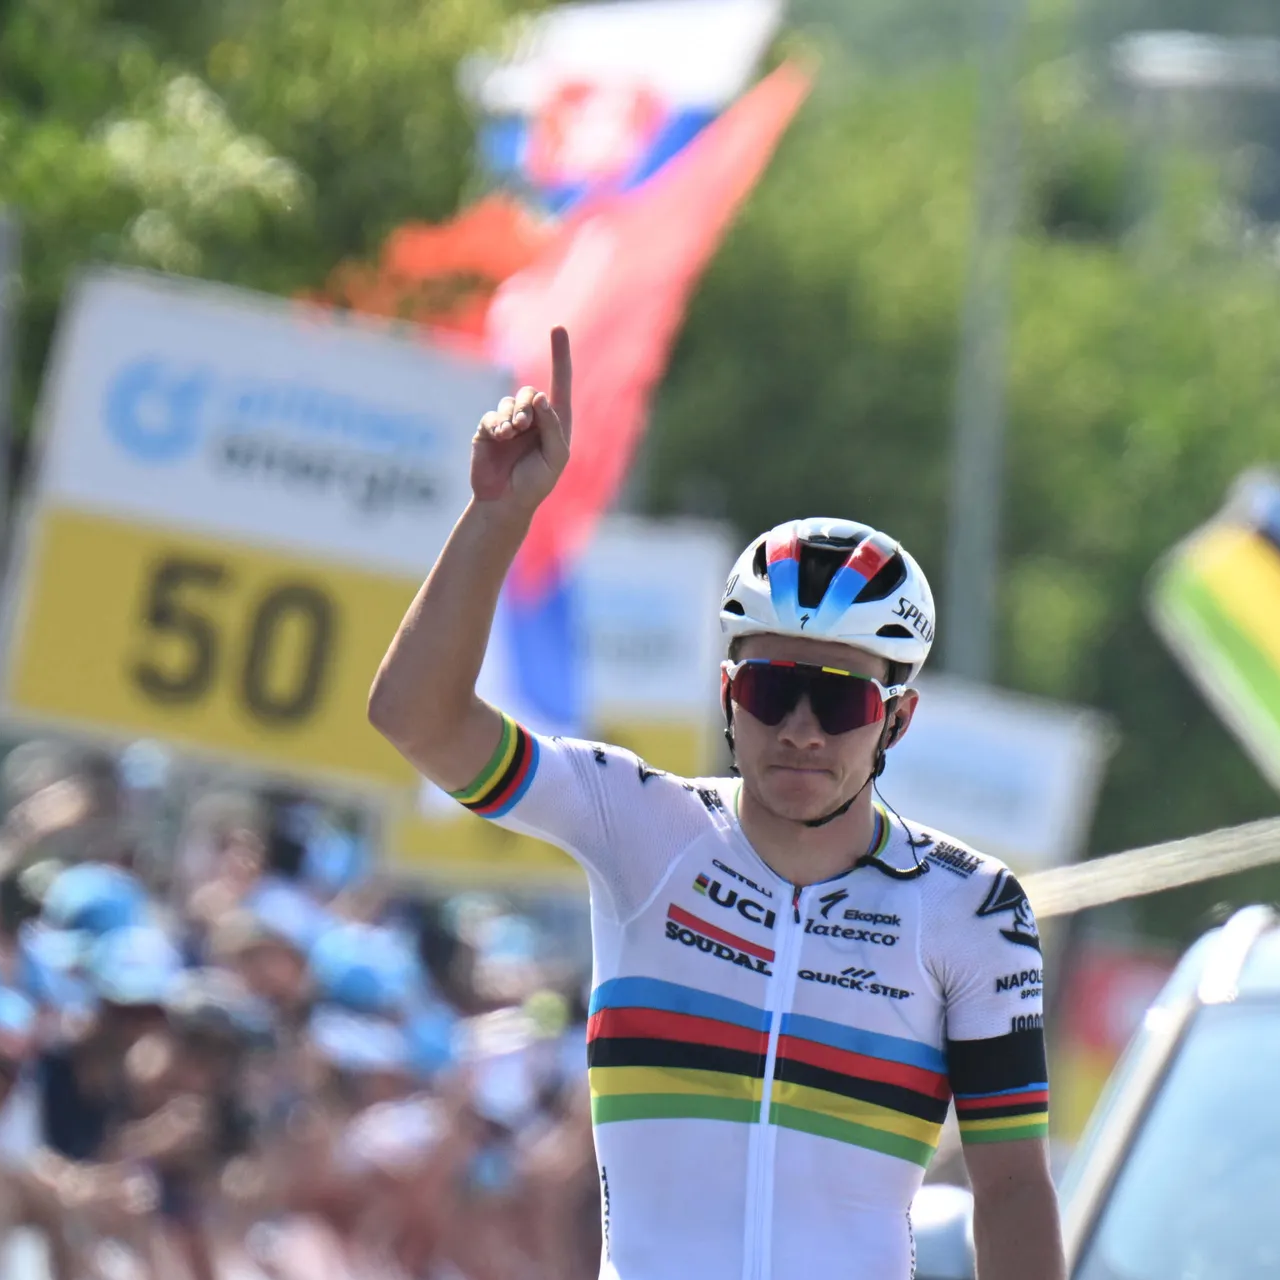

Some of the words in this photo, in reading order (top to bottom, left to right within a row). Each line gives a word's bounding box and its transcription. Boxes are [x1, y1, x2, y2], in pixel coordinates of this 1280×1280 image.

[133, 553, 339, 730] 50
[708, 880, 776, 930] UCI
[843, 909, 901, 927] Ekopak
[665, 921, 773, 977] SOUDAL
[804, 918, 899, 946] latexco
